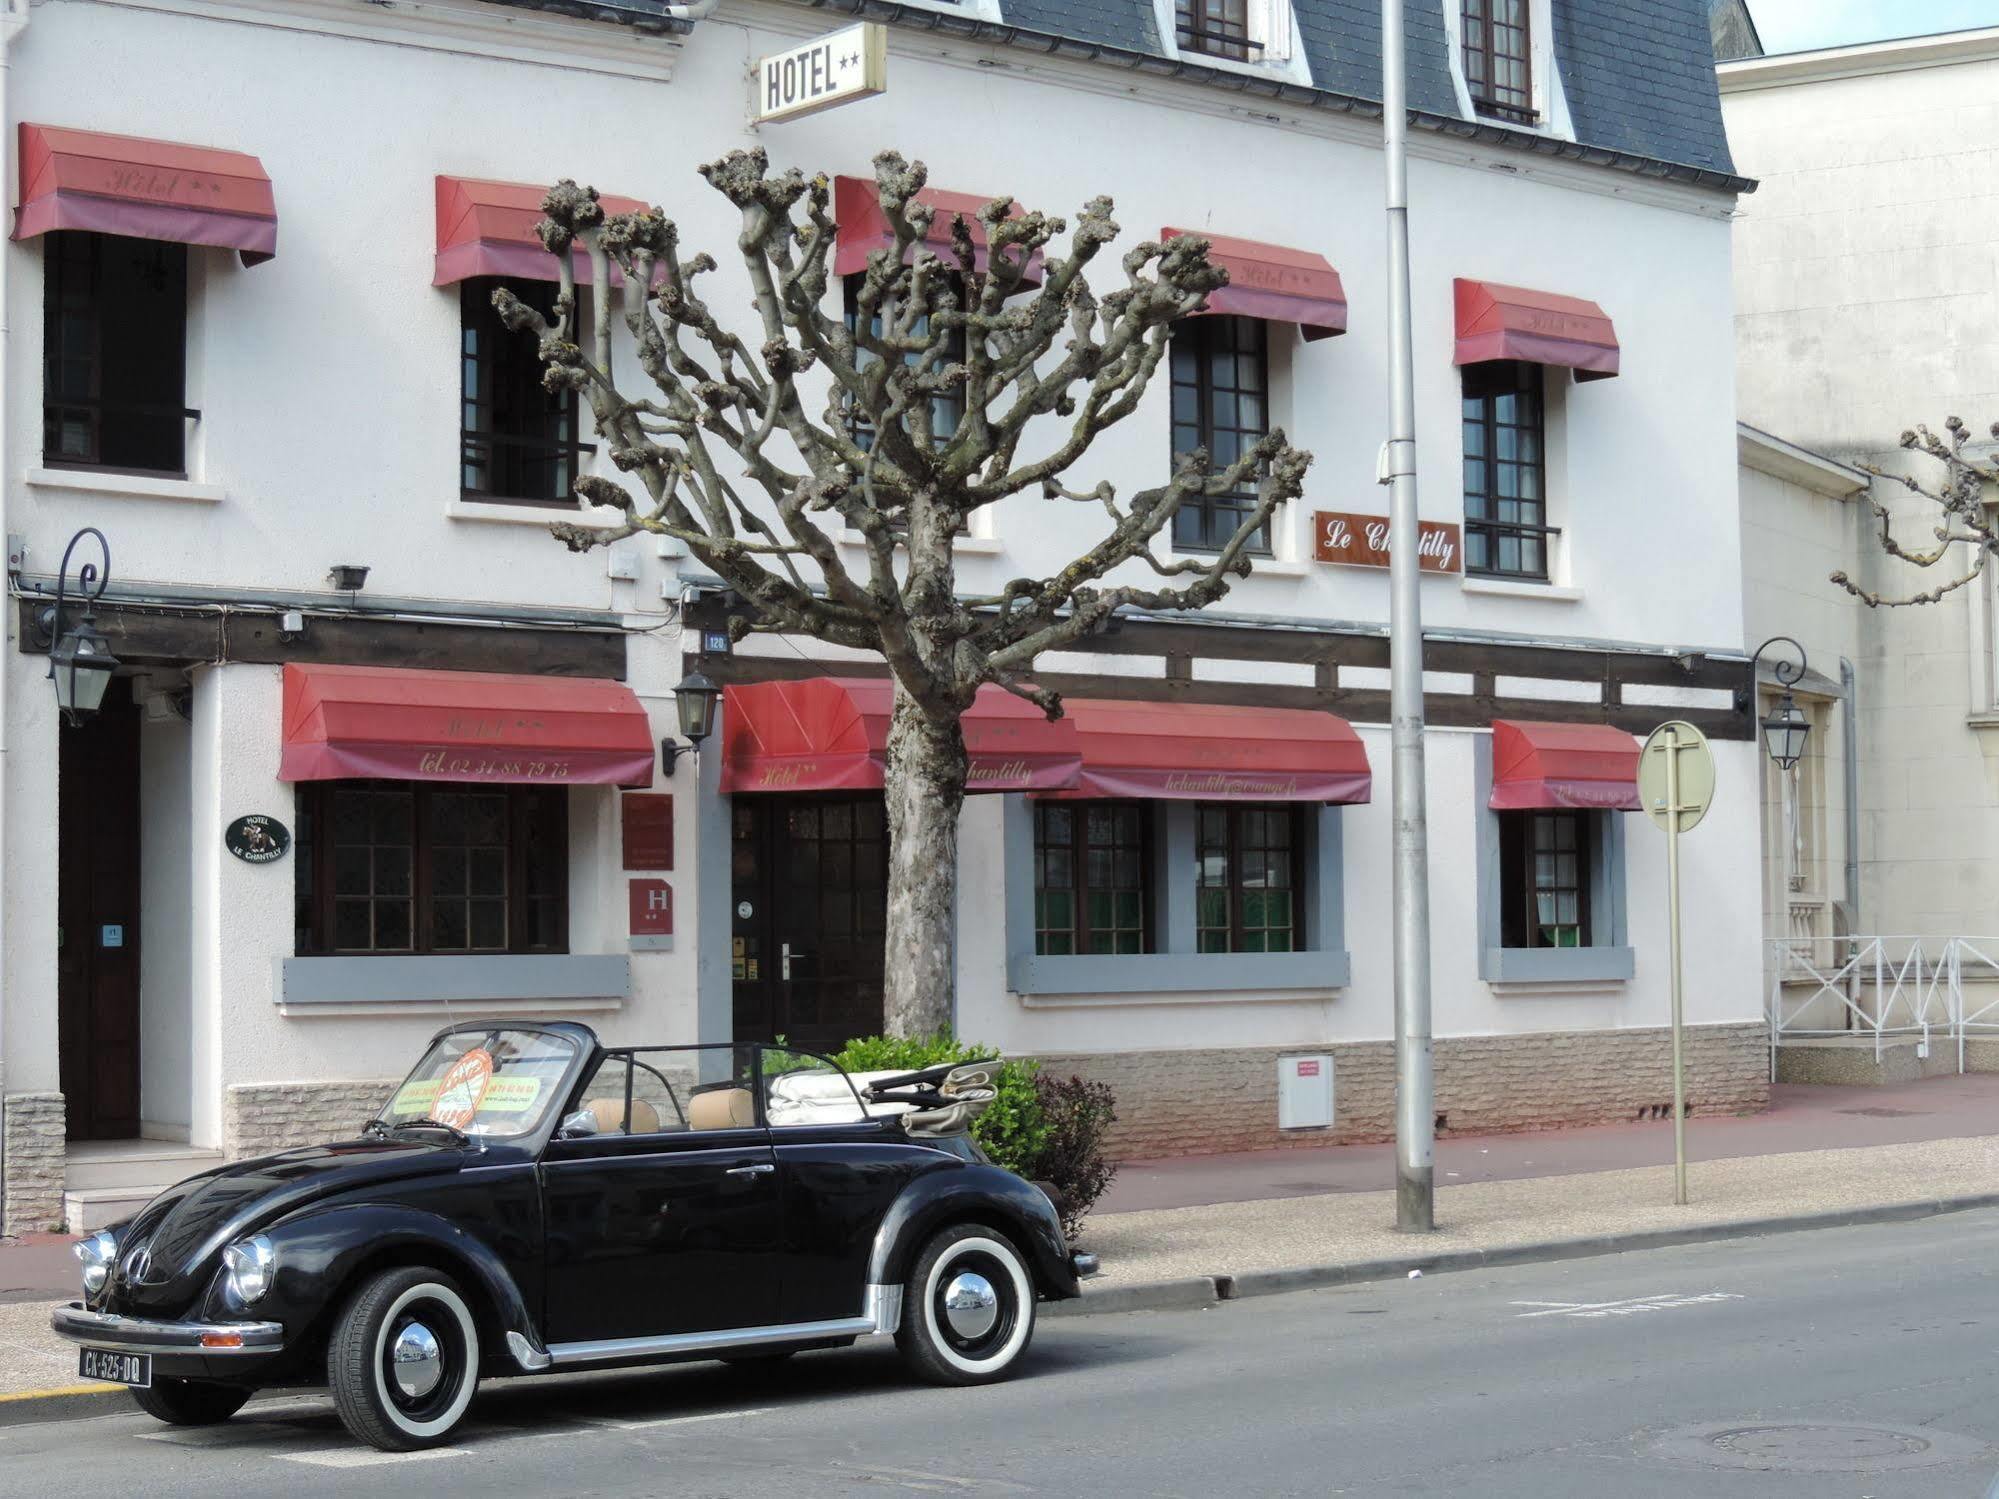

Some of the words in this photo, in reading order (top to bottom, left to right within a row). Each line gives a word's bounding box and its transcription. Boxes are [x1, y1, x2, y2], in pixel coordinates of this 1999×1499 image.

[768, 45, 837, 110] HOTEL
[1324, 519, 1351, 549] Le
[1365, 522, 1454, 569] Chtilly
[710, 636, 724, 648] 120
[450, 760, 469, 774] 02
[246, 816, 269, 825] HOTEL
[234, 846, 243, 856] LE
[245, 847, 281, 860] CHANTILLY
[648, 890, 668, 910] H
